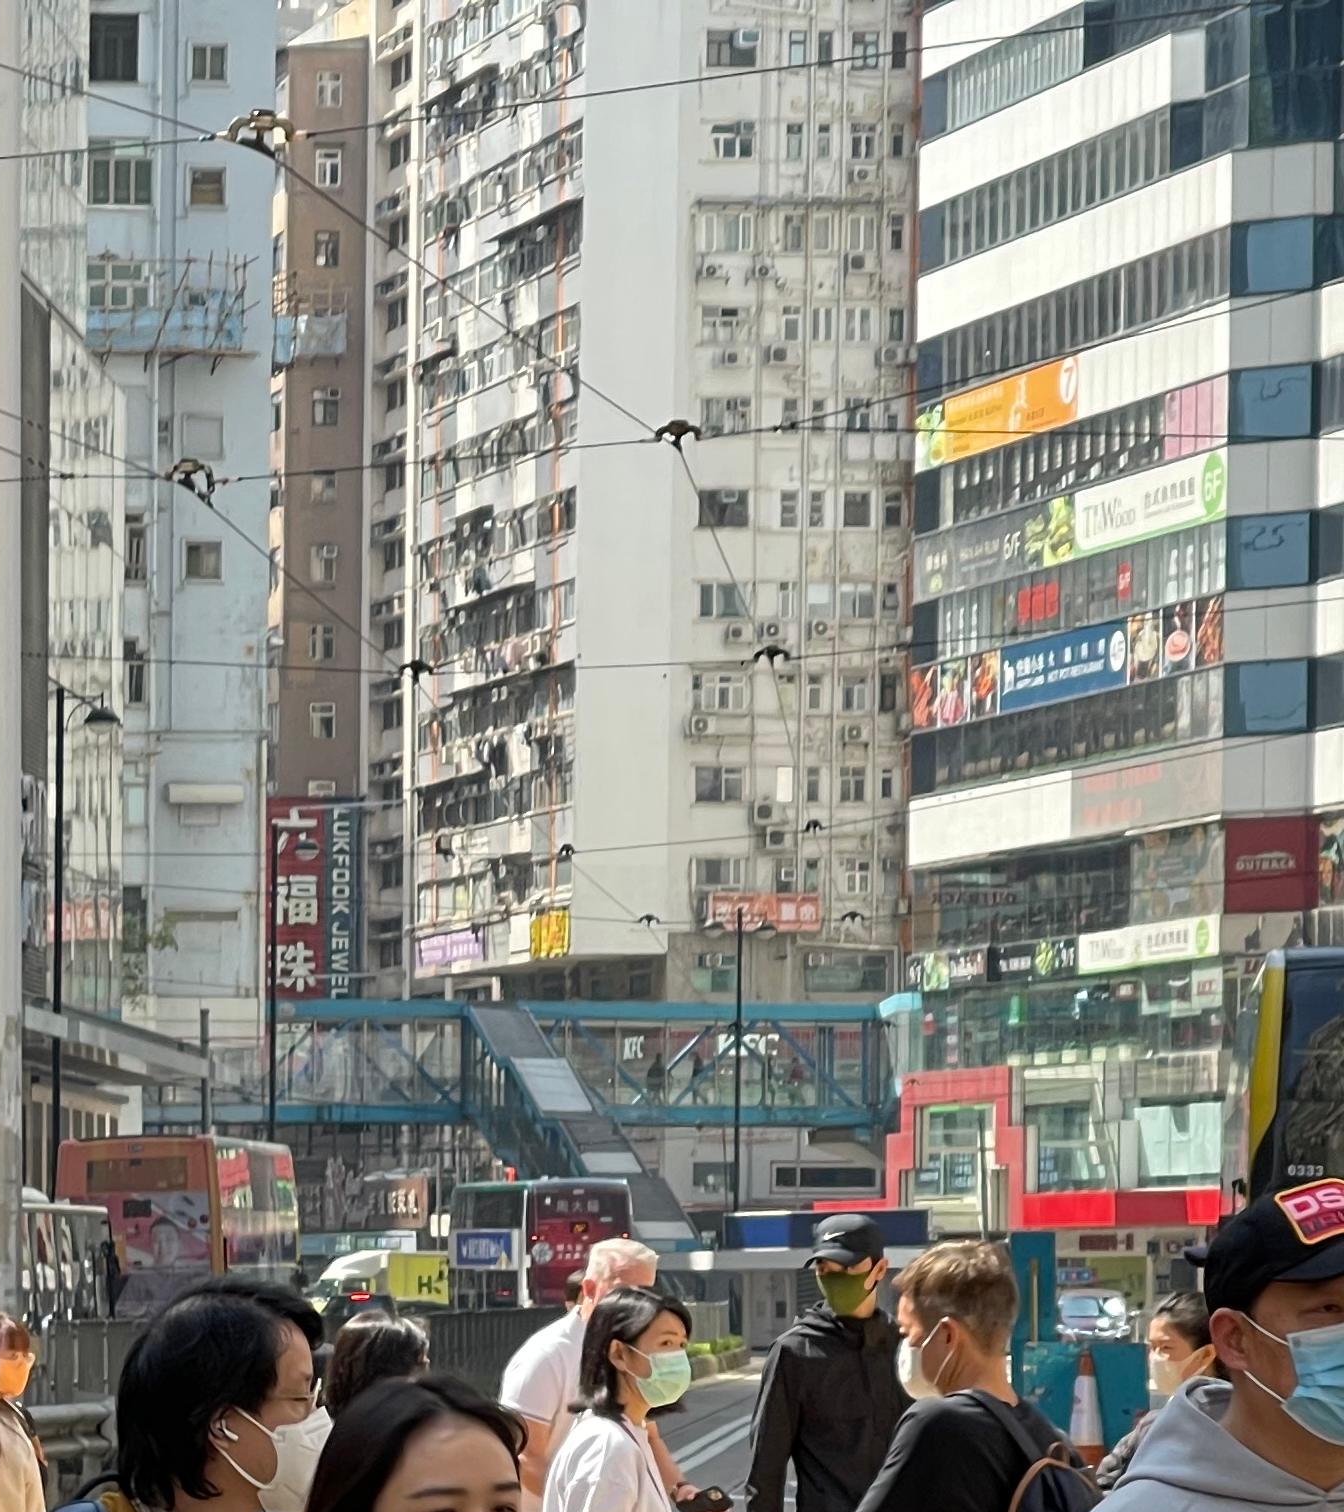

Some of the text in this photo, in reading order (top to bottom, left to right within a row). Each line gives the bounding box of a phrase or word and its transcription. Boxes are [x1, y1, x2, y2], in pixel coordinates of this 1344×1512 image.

[1204, 468, 1223, 502] 6F
[1003, 531, 1021, 561] 6/F
[331, 807, 350, 914] LUKFOOK
[1235, 856, 1297, 871] OUTBACK
[623, 1034, 644, 1060] KFC
[717, 1032, 780, 1057] KFC
